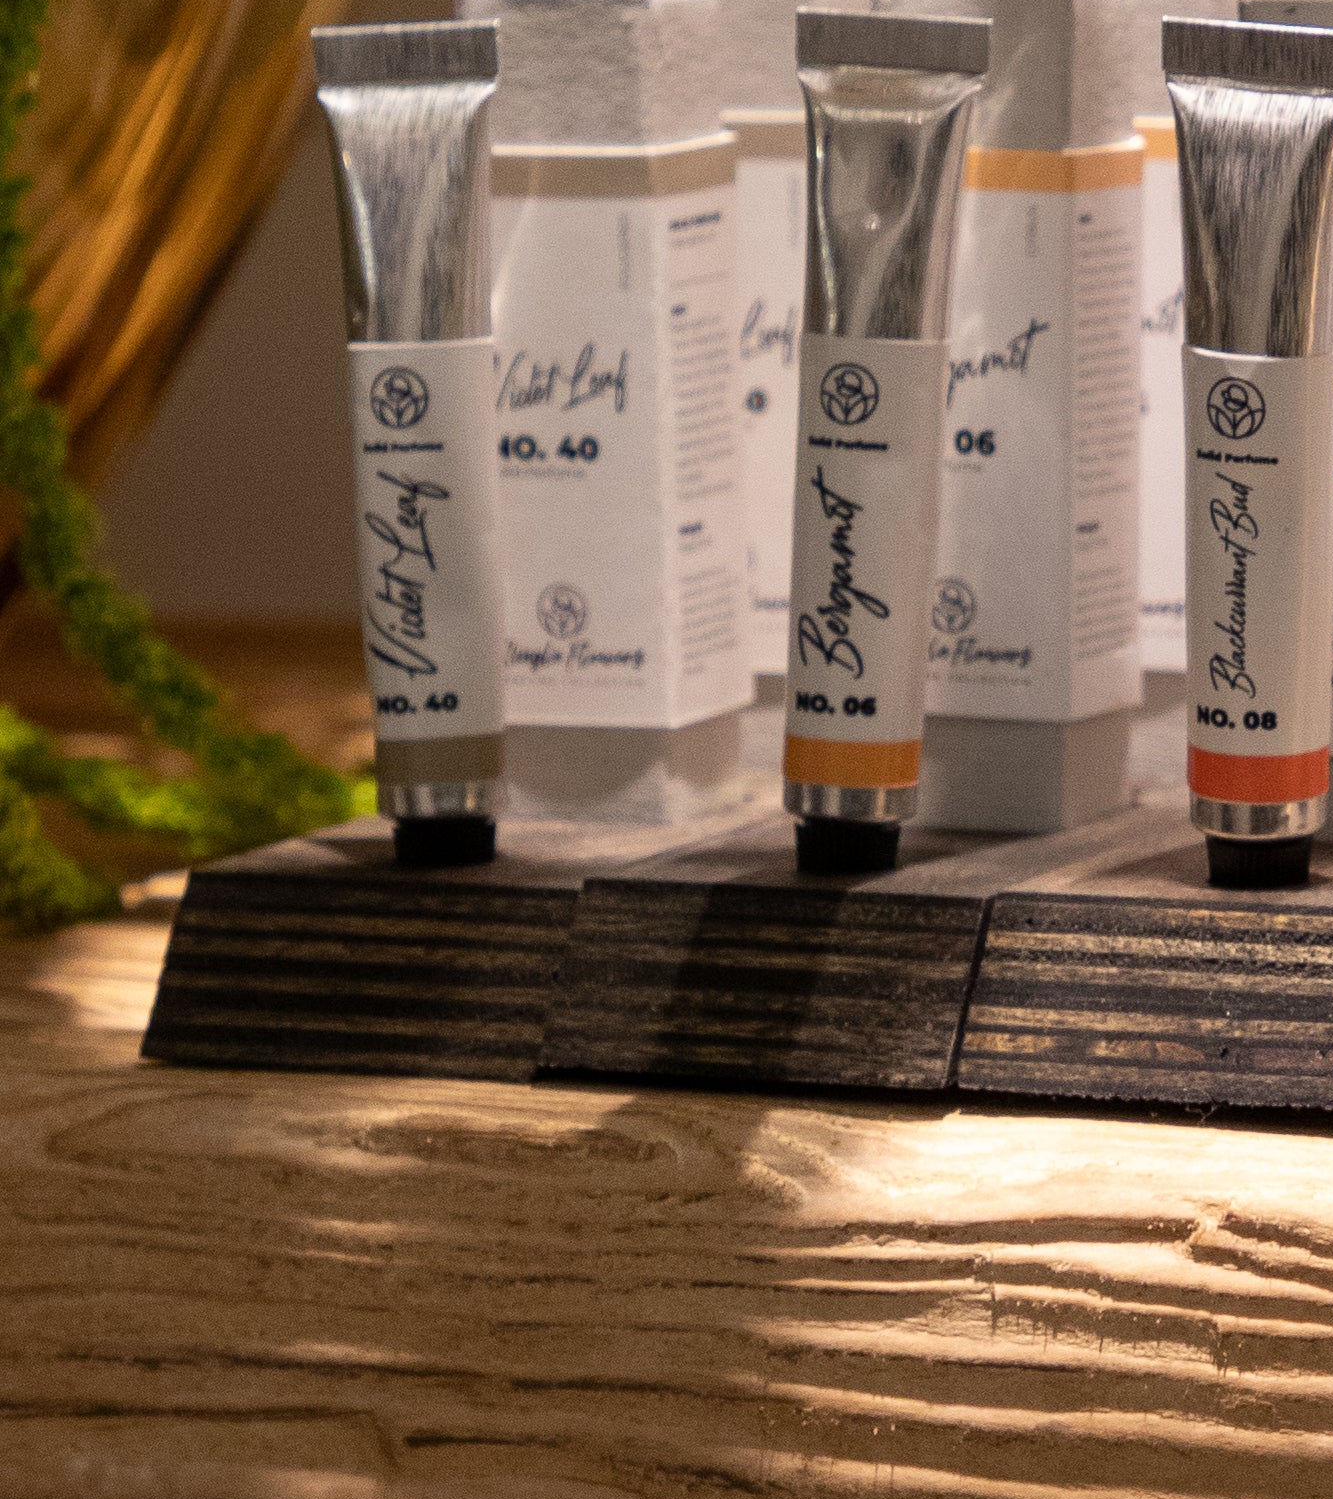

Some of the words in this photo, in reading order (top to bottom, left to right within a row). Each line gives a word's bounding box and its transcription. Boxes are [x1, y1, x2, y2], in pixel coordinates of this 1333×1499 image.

[746, 388, 768, 413] 0
[557, 434, 600, 462] 40
[954, 429, 997, 457] 06
[1197, 448, 1223, 461] Solid
[1225, 451, 1280, 466] Perfume
[1209, 470, 1260, 541] Bud
[364, 469, 450, 573] Leaf
[798, 463, 892, 681] Bergamot
[1208, 528, 1258, 700] Blackcurrant
[377, 693, 417, 714] NO.
[424, 690, 459, 713] 40
[795, 690, 836, 715] NO.
[842, 696, 877, 718] 06
[1196, 704, 1236, 730] NO.
[1243, 710, 1279, 731] 08
